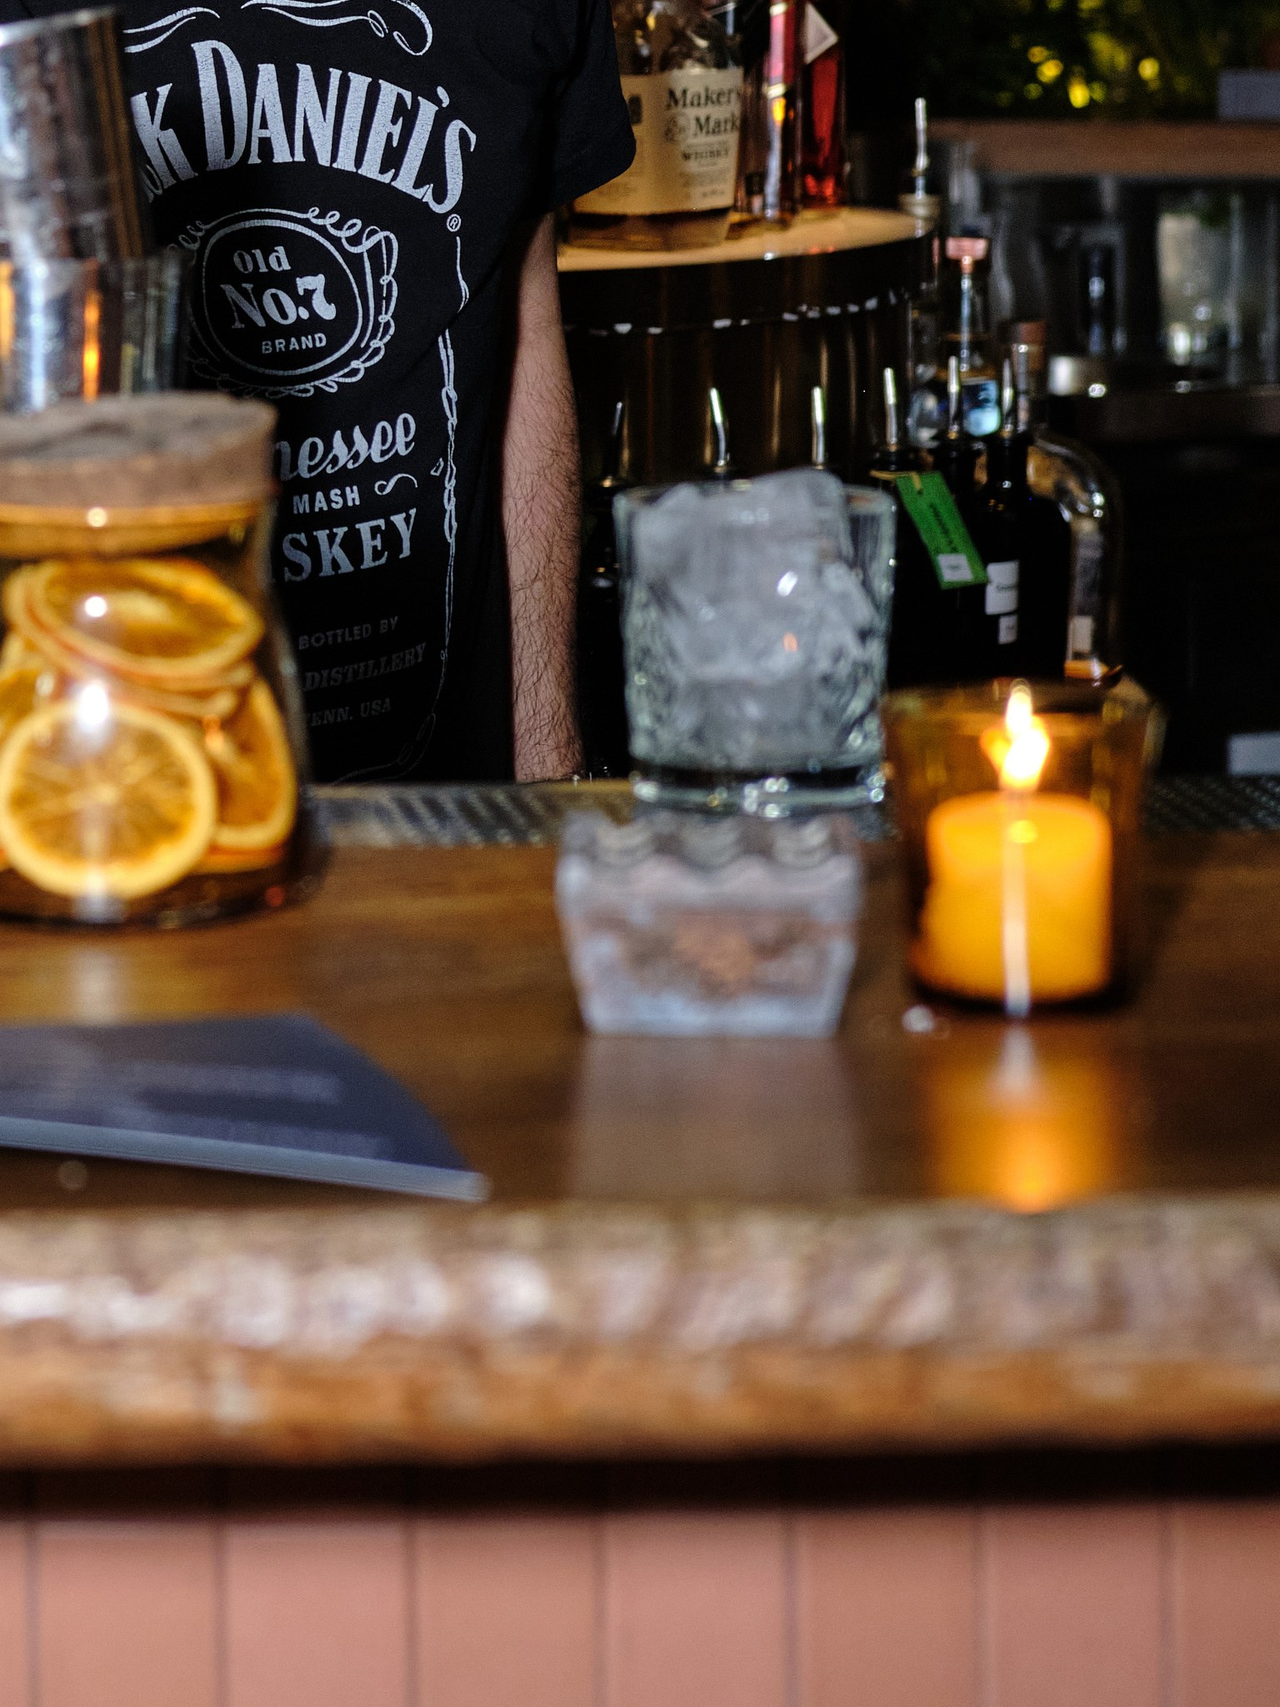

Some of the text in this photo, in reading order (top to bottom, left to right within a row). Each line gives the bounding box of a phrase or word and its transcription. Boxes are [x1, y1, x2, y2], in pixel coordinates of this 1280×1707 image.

[190, 39, 478, 214] DANIEL'S
[233, 245, 292, 275] Old
[261, 332, 328, 355] BRAND
[292, 484, 361, 515] MASH
[276, 507, 417, 583] SKEY
[297, 615, 400, 651] BOTTLED BY
[303, 641, 427, 692] DISTILLERY
[308, 697, 393, 728] ENN. USA
